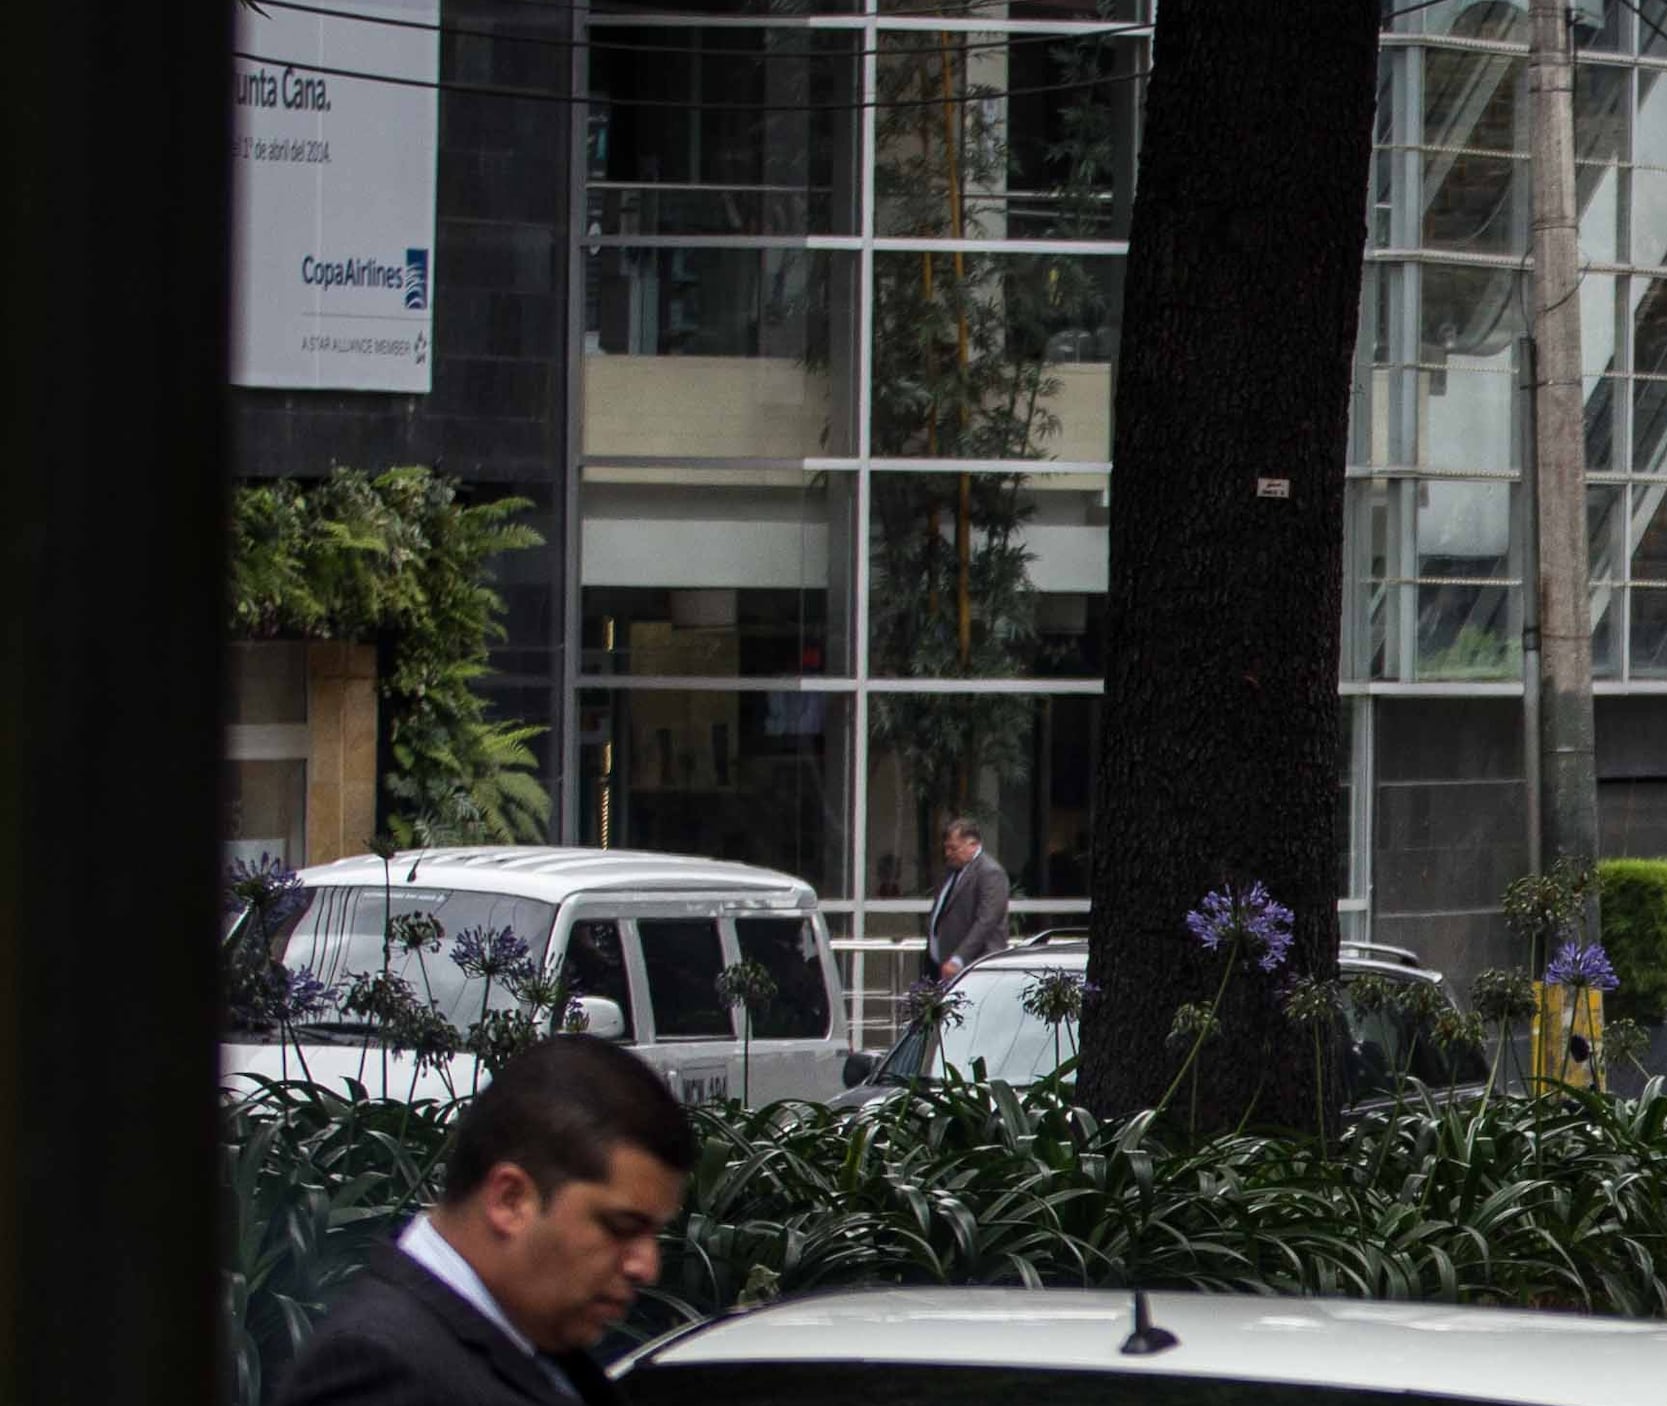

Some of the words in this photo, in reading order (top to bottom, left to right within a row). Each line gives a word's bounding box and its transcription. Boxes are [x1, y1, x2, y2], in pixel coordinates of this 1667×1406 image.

[233, 68, 278, 108] unta
[282, 66, 331, 111] Cana.
[302, 255, 404, 292] CopaAirlines
